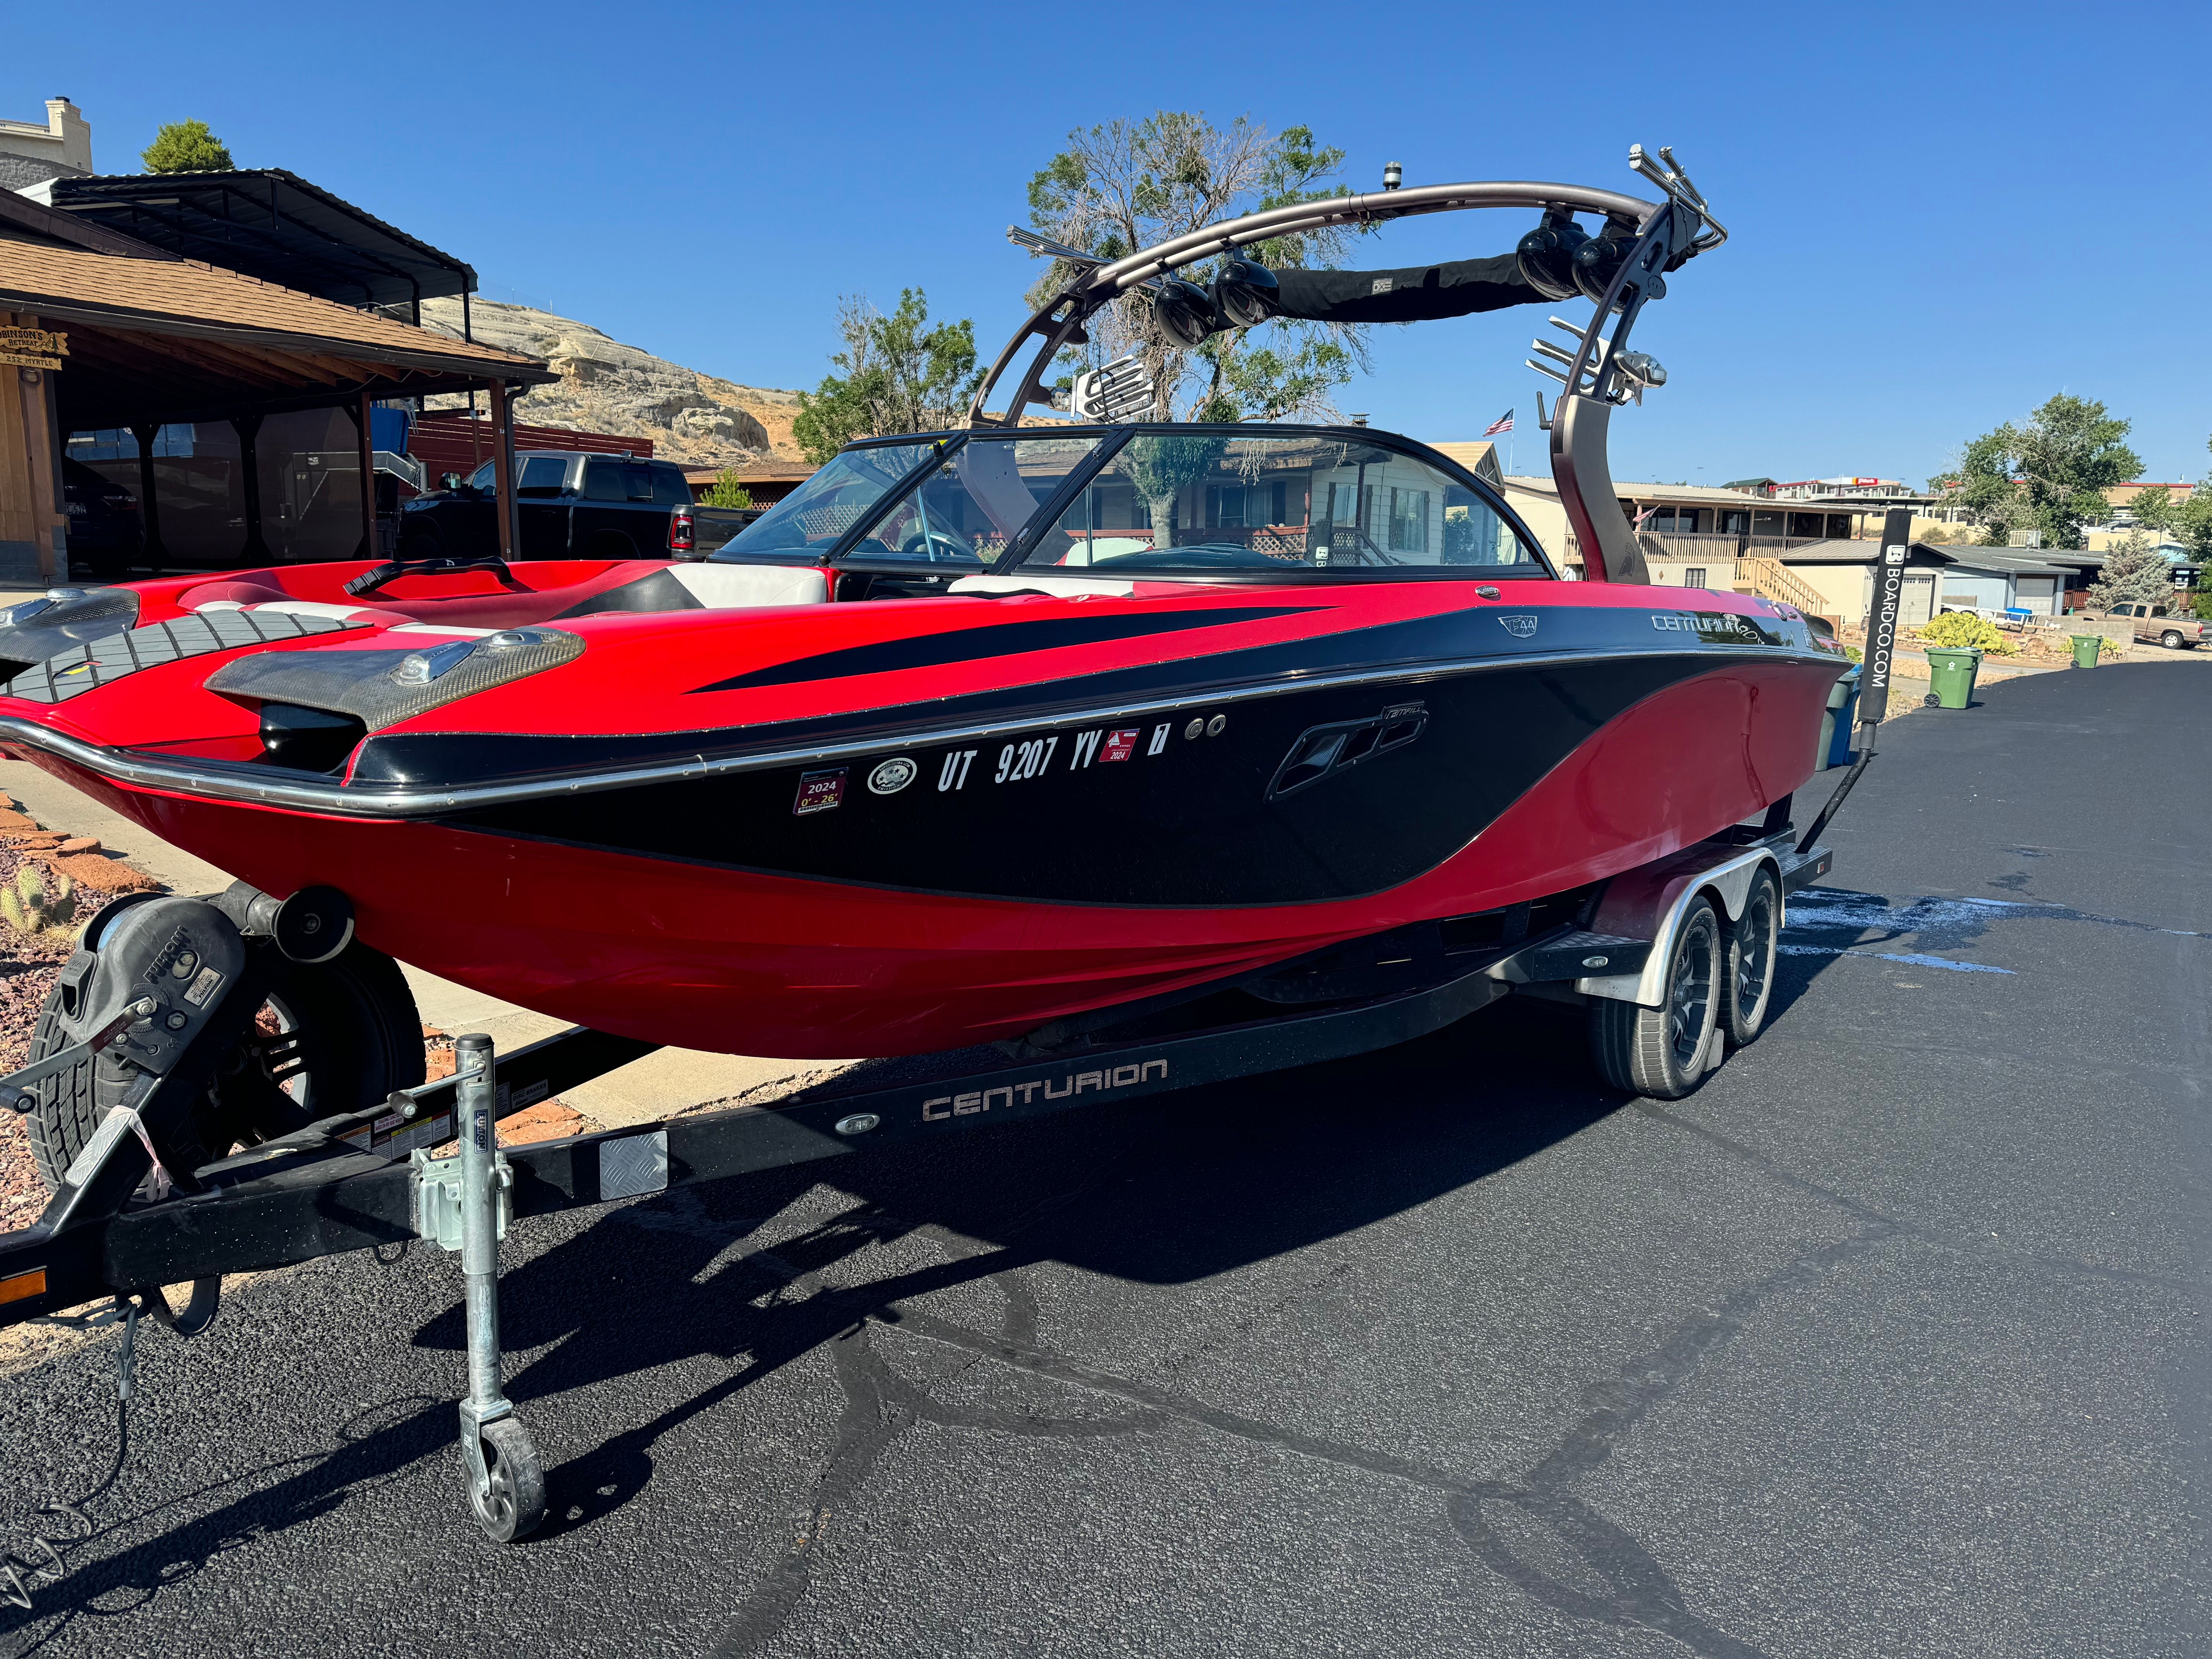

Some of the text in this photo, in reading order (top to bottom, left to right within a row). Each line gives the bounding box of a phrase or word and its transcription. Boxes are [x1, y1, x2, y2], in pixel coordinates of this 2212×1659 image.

[0, 330, 43, 340] BINSON'S
[25, 358, 53, 366] MYRTLE
[1872, 568, 1900, 687] BOARDCO.COM
[1110, 751, 1126, 759] 2024
[938, 750, 978, 792] UT
[995, 737, 1059, 784] 9207
[807, 781, 836, 794] 2024
[821, 793, 838, 804] 26'
[198, 979, 213, 998] FULTON
[526, 1083, 546, 1095] BRAKES
[923, 1059, 1167, 1121] CENTURION
[401, 1123, 417, 1132] CAUTION
[477, 1112, 486, 1150] FULTON
[374, 1136, 390, 1145] DANGER
